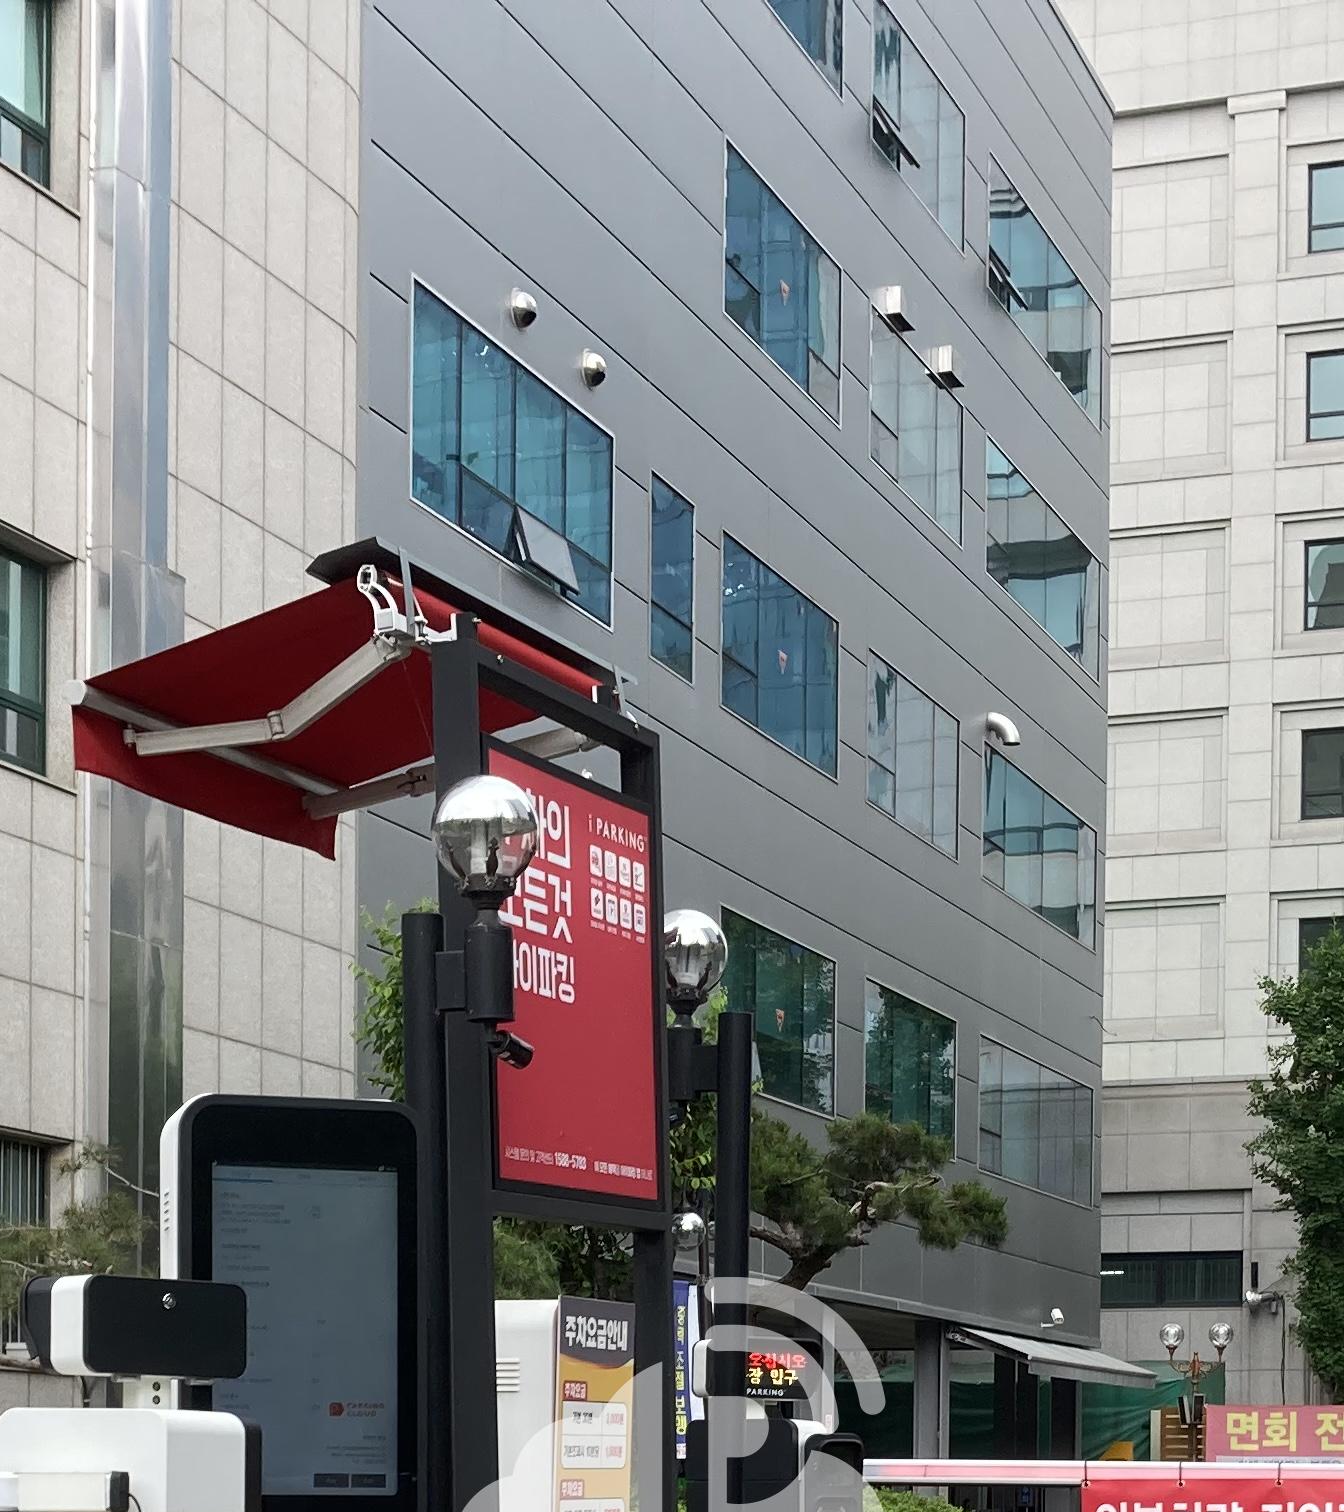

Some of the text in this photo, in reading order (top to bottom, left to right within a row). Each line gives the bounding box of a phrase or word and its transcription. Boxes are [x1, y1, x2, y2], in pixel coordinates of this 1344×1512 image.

[596, 817, 645, 853] PARKING
[565, 1315, 629, 1351] 주차요금안내
[746, 1388, 785, 1397] PARKING
[1225, 1411, 1298, 1452] 면회
